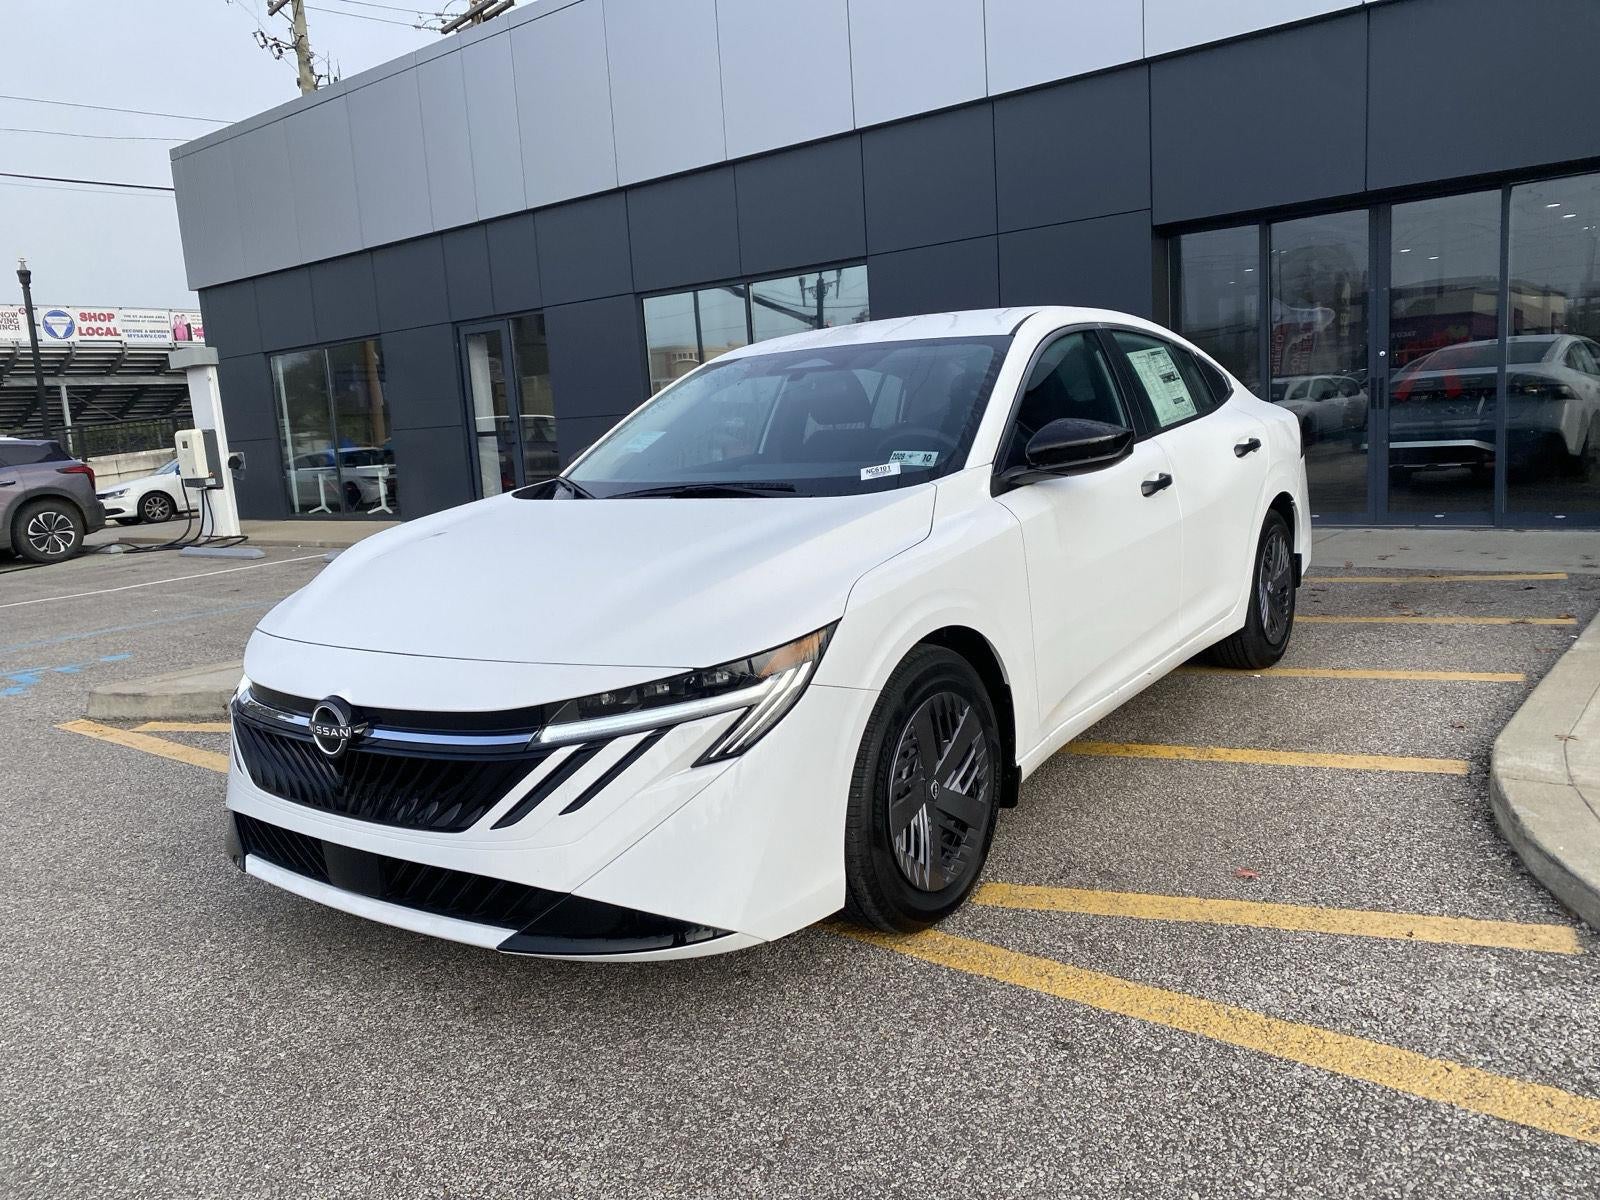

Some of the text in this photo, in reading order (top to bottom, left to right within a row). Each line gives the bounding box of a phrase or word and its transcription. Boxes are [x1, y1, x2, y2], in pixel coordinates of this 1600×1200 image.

[79, 312, 115, 322] SHOP
[78, 327, 121, 336] LOCAL
[922, 454, 932, 462] 10
[309, 724, 349, 737] NISSAN
